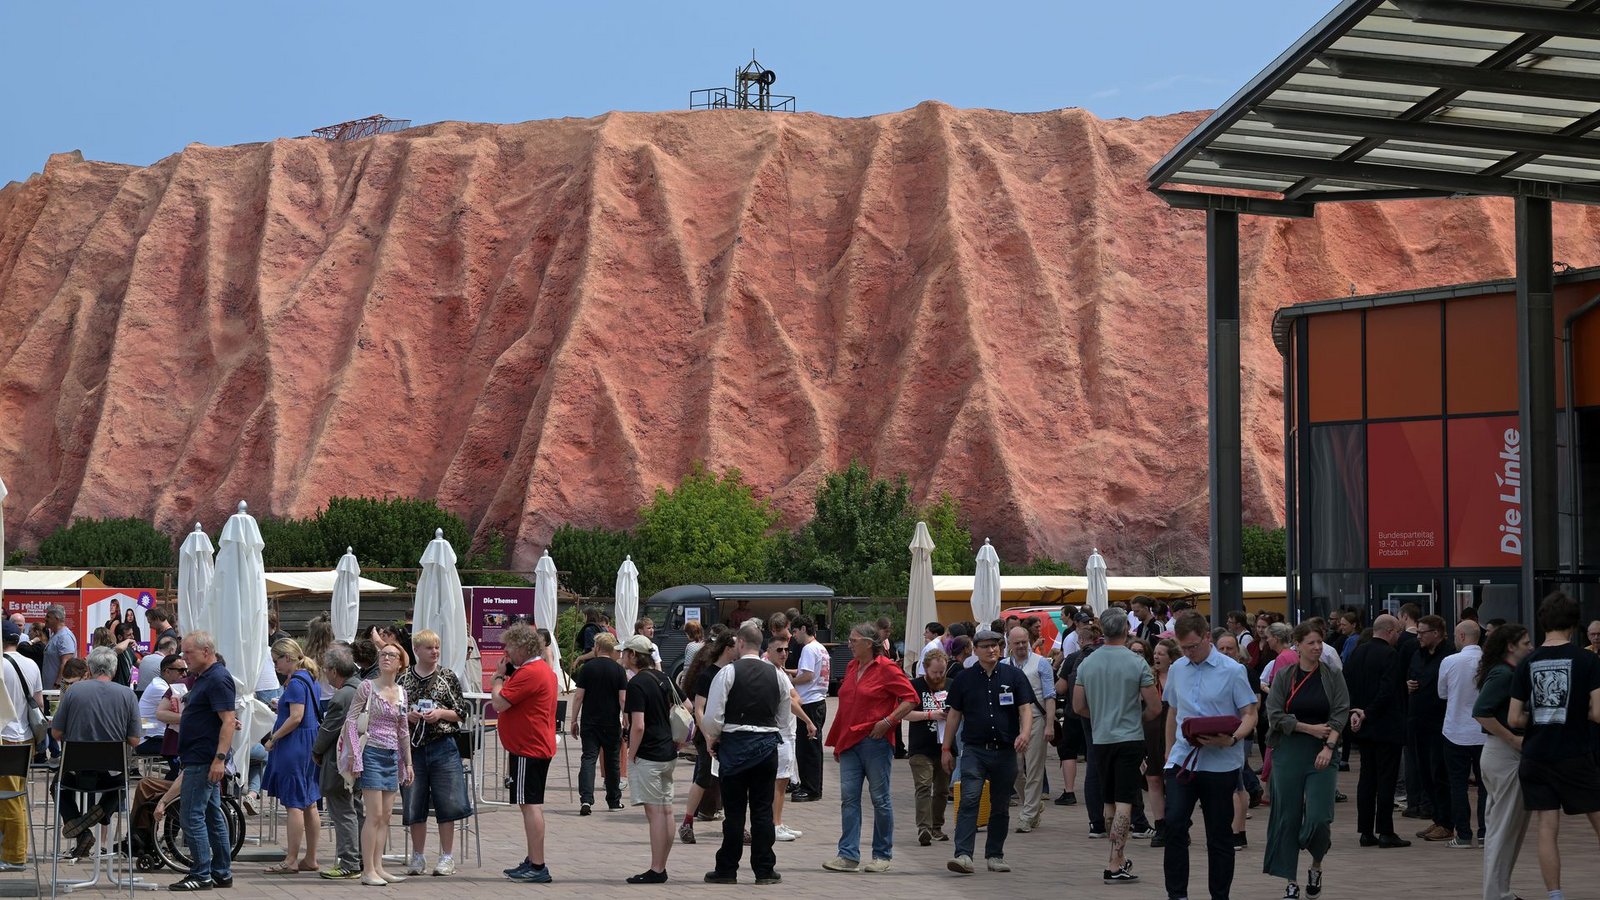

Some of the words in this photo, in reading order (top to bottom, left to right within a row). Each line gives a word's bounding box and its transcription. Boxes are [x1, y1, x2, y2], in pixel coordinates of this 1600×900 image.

[1378, 531, 1434, 539] Bundesparteitag
[1499, 508, 1521, 555] Die
[1416, 539, 1434, 547] 2026
[9, 601, 20, 610] Es
